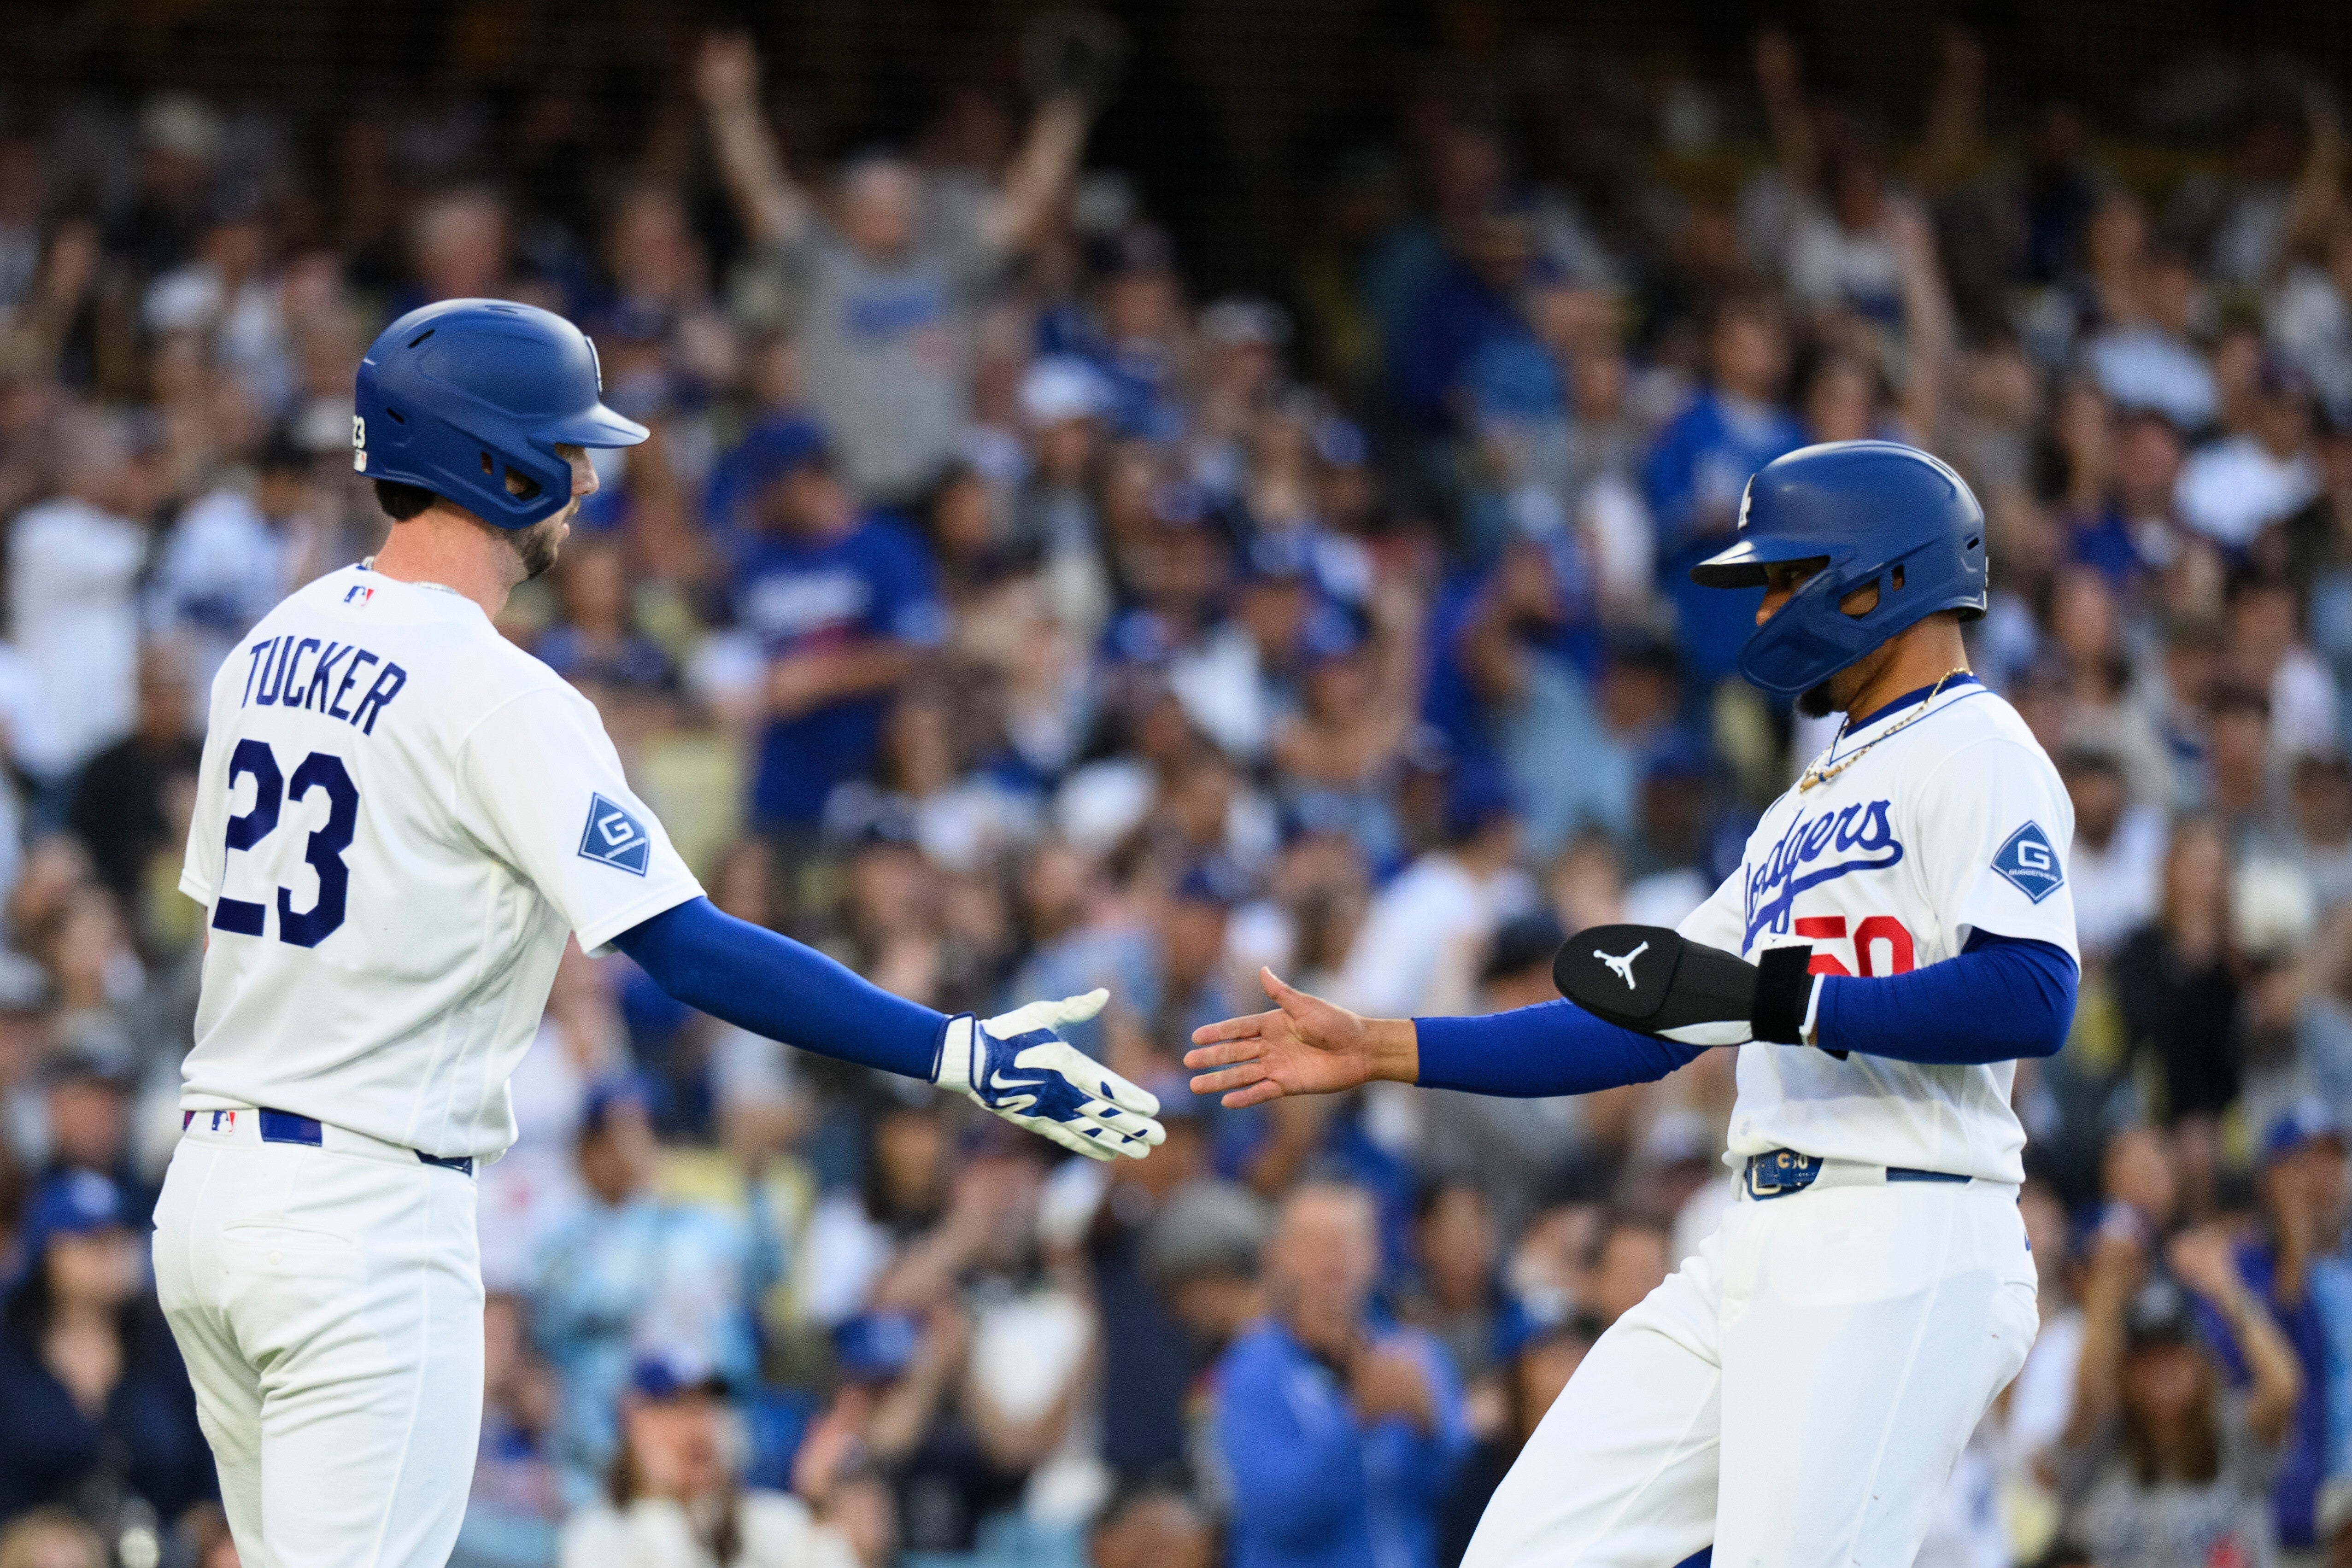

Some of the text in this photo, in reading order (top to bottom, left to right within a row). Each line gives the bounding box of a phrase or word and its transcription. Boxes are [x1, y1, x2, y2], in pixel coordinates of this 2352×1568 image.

[241, 636, 407, 737] TUCKER
[211, 738, 360, 948] 23
[598, 811, 634, 846] G
[1742, 799, 1903, 957] odgers
[2018, 839, 2050, 870] G
